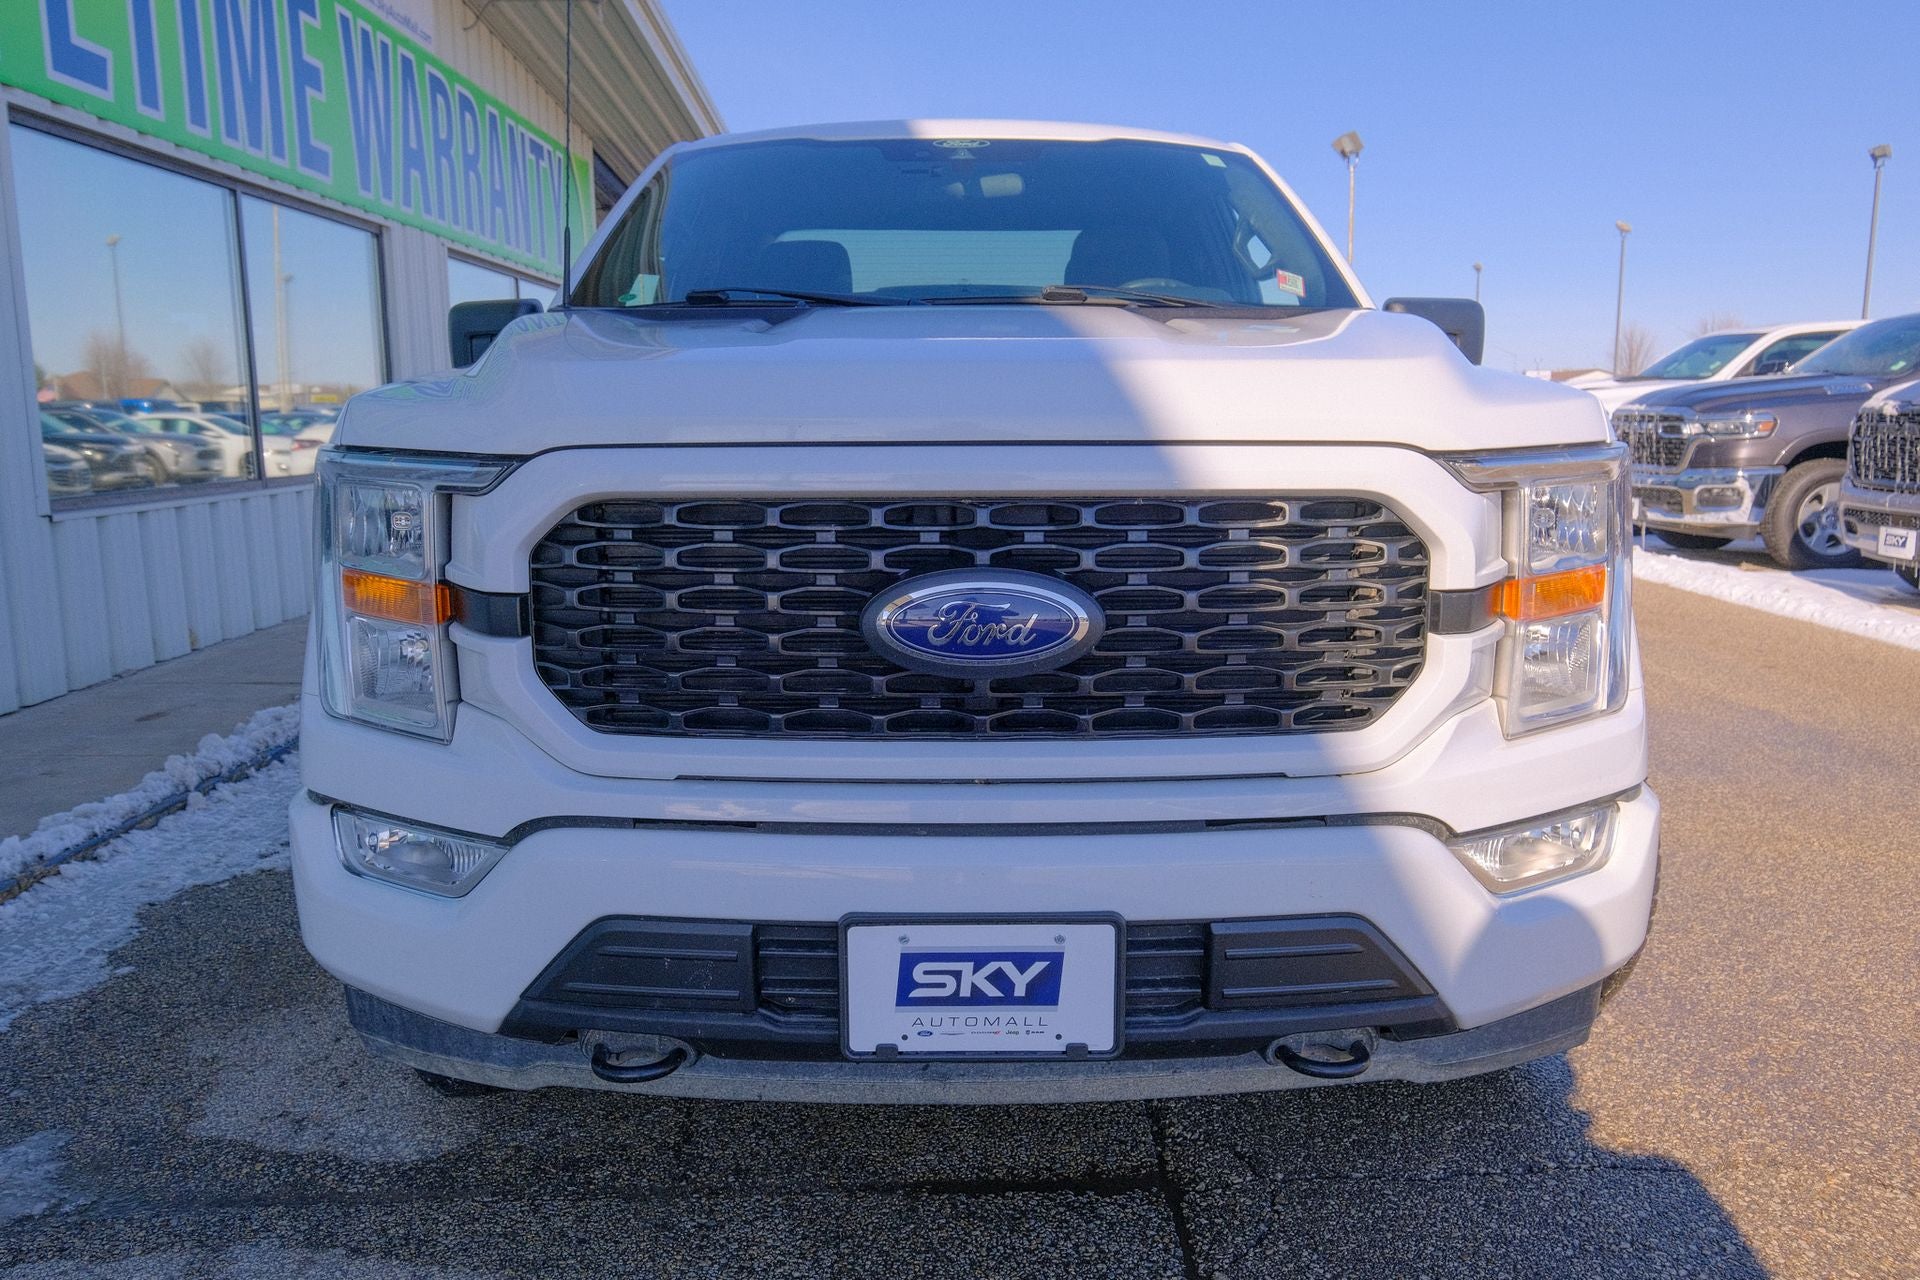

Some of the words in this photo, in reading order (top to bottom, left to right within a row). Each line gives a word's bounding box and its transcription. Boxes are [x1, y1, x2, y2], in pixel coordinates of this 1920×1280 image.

[335, 3, 563, 266] WARRANTY
[1886, 534, 1907, 547] SKY
[926, 600, 1039, 647] Ford
[907, 961, 1051, 998] SKY
[911, 1016, 1049, 1028] AUTOMALL
